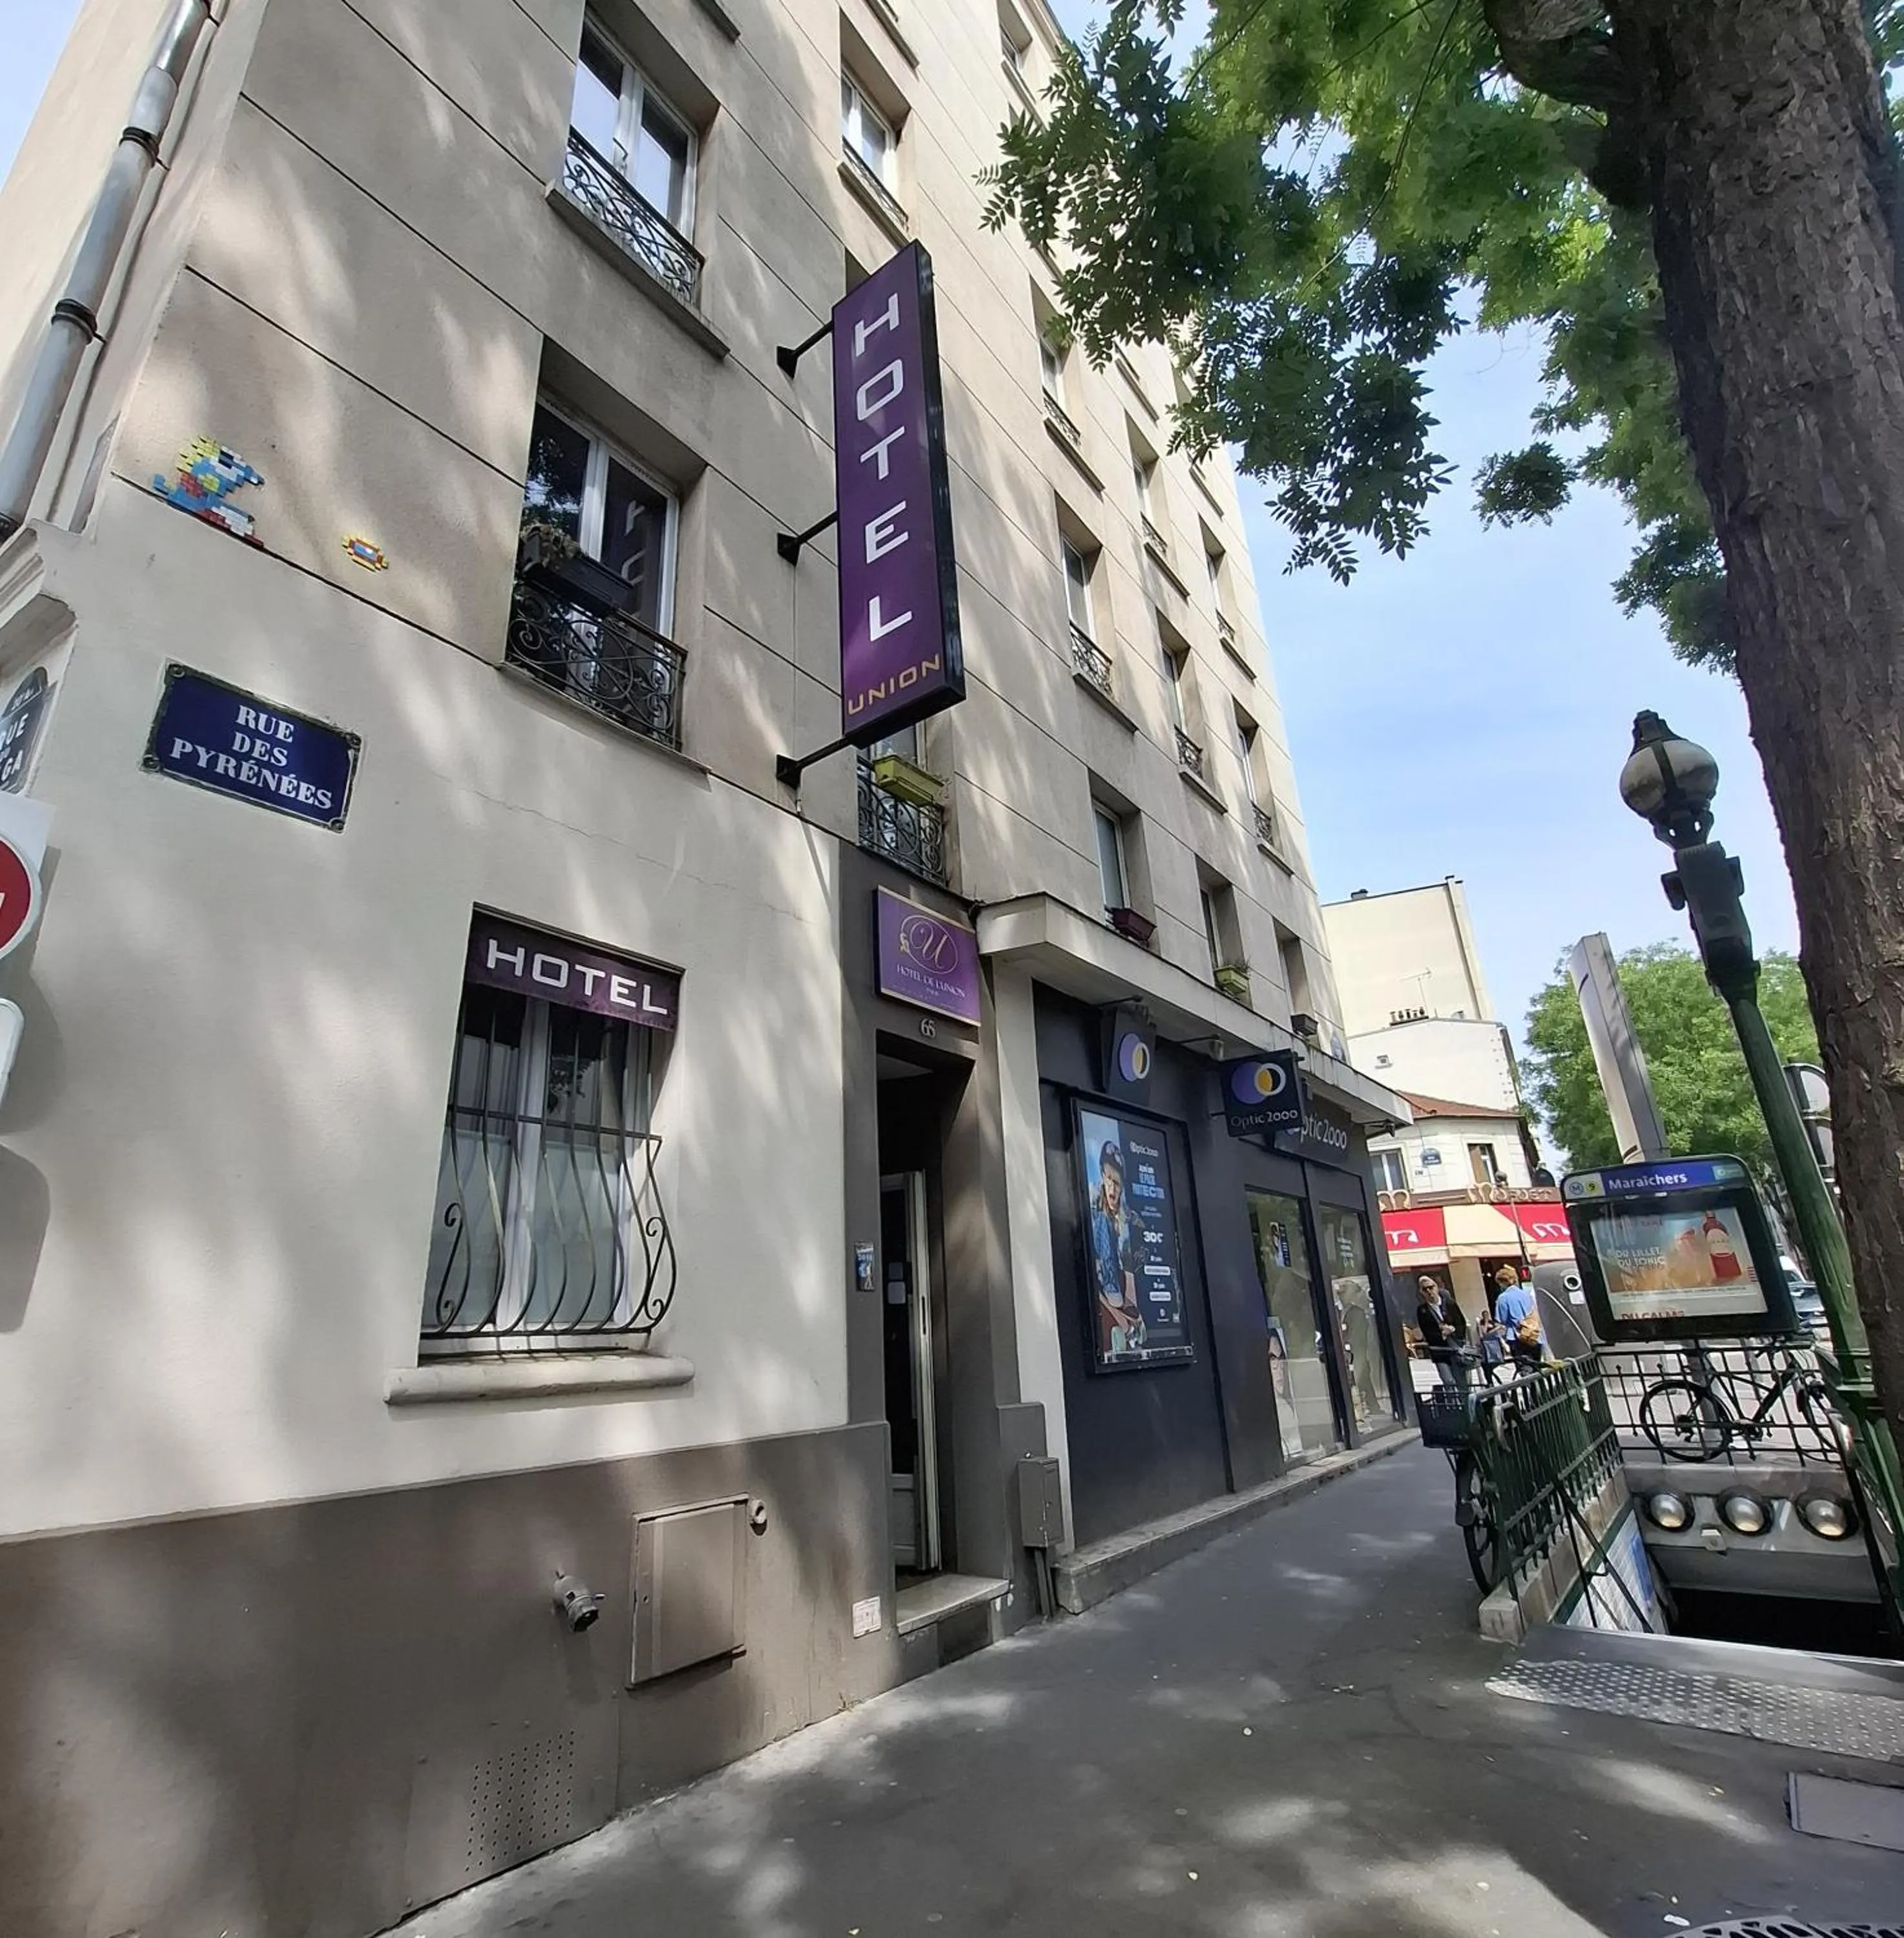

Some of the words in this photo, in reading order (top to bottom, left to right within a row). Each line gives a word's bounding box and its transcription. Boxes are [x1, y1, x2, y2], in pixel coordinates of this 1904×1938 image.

[854, 292, 913, 642] HOTEL
[848, 652, 942, 715] UNION
[233, 731, 288, 767] DES
[236, 704, 295, 743] RUE
[169, 737, 333, 810] PYRÉNÉES
[486, 939, 668, 1016] HOTEL
[921, 1018, 936, 1039] 65
[1608, 1172, 1688, 1191] Maraîchers
